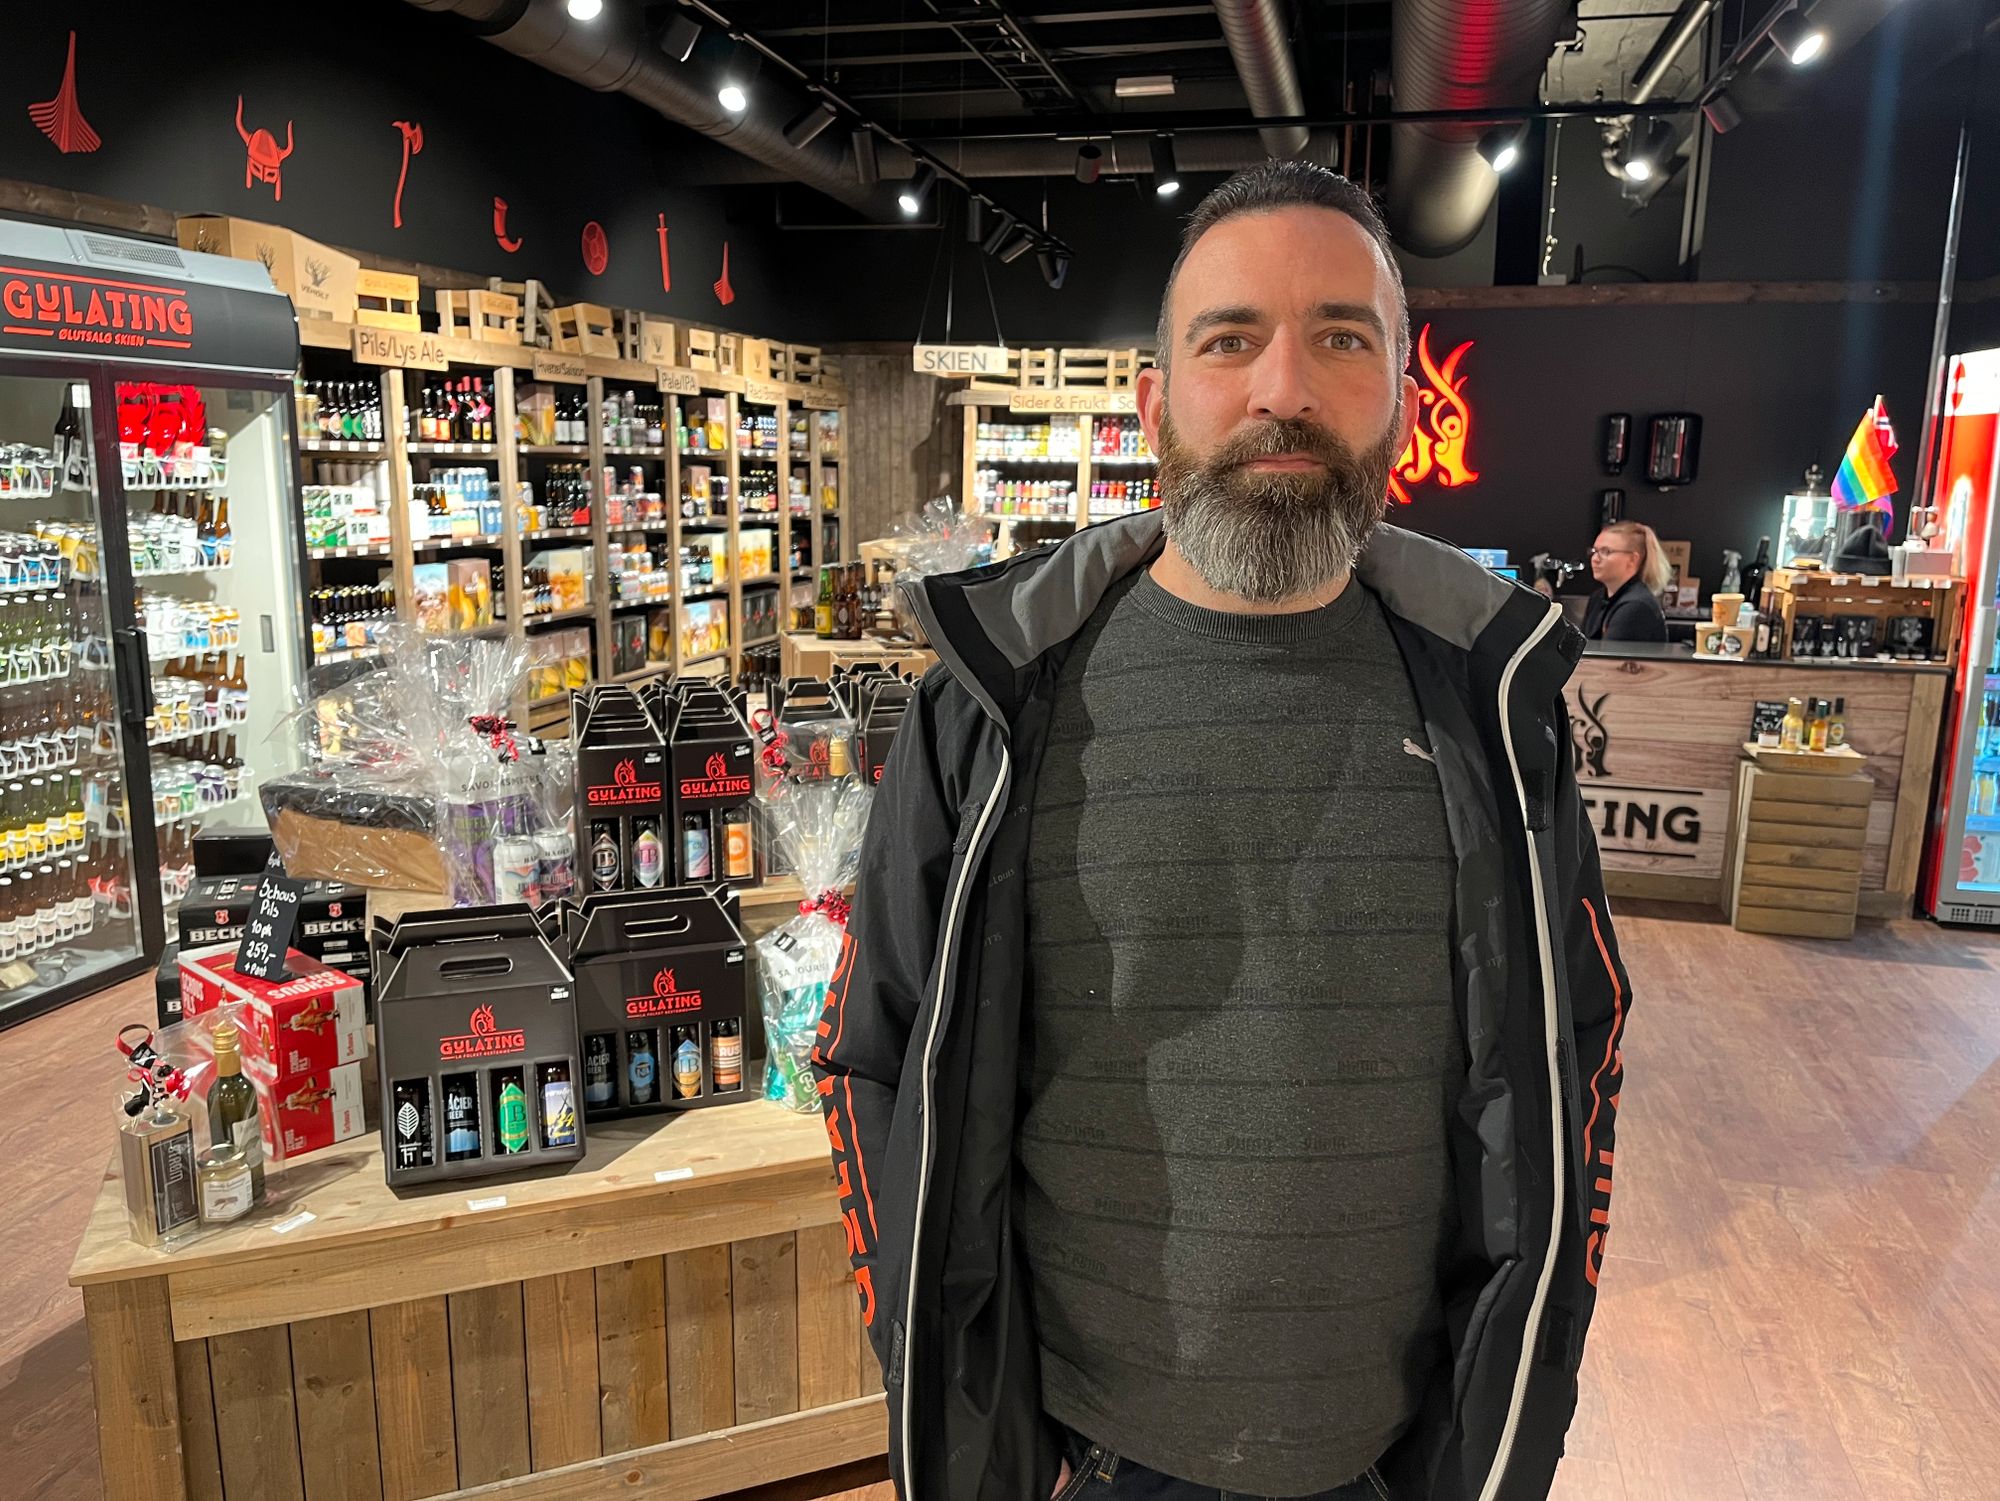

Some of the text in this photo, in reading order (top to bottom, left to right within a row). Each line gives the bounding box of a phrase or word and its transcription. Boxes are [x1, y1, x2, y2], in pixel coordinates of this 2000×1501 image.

[3, 279, 193, 336] GULATING
[58, 328, 145, 347] ØLUTSALG SKIEN
[359, 331, 445, 366] Pils/Lys Ale
[923, 350, 988, 371] SKIEN
[1012, 395, 1049, 409] Sider
[1052, 396, 1065, 409] &
[1070, 395, 1108, 409] Frukt
[587, 786, 662, 802] GULATING
[681, 779, 751, 795] GULATING
[258, 877, 297, 903] Schous
[259, 899, 280, 918] Pils
[266, 972, 347, 1000] SCHOUS
[626, 994, 703, 1014] GULATING
[440, 1033, 525, 1055] GULATING
